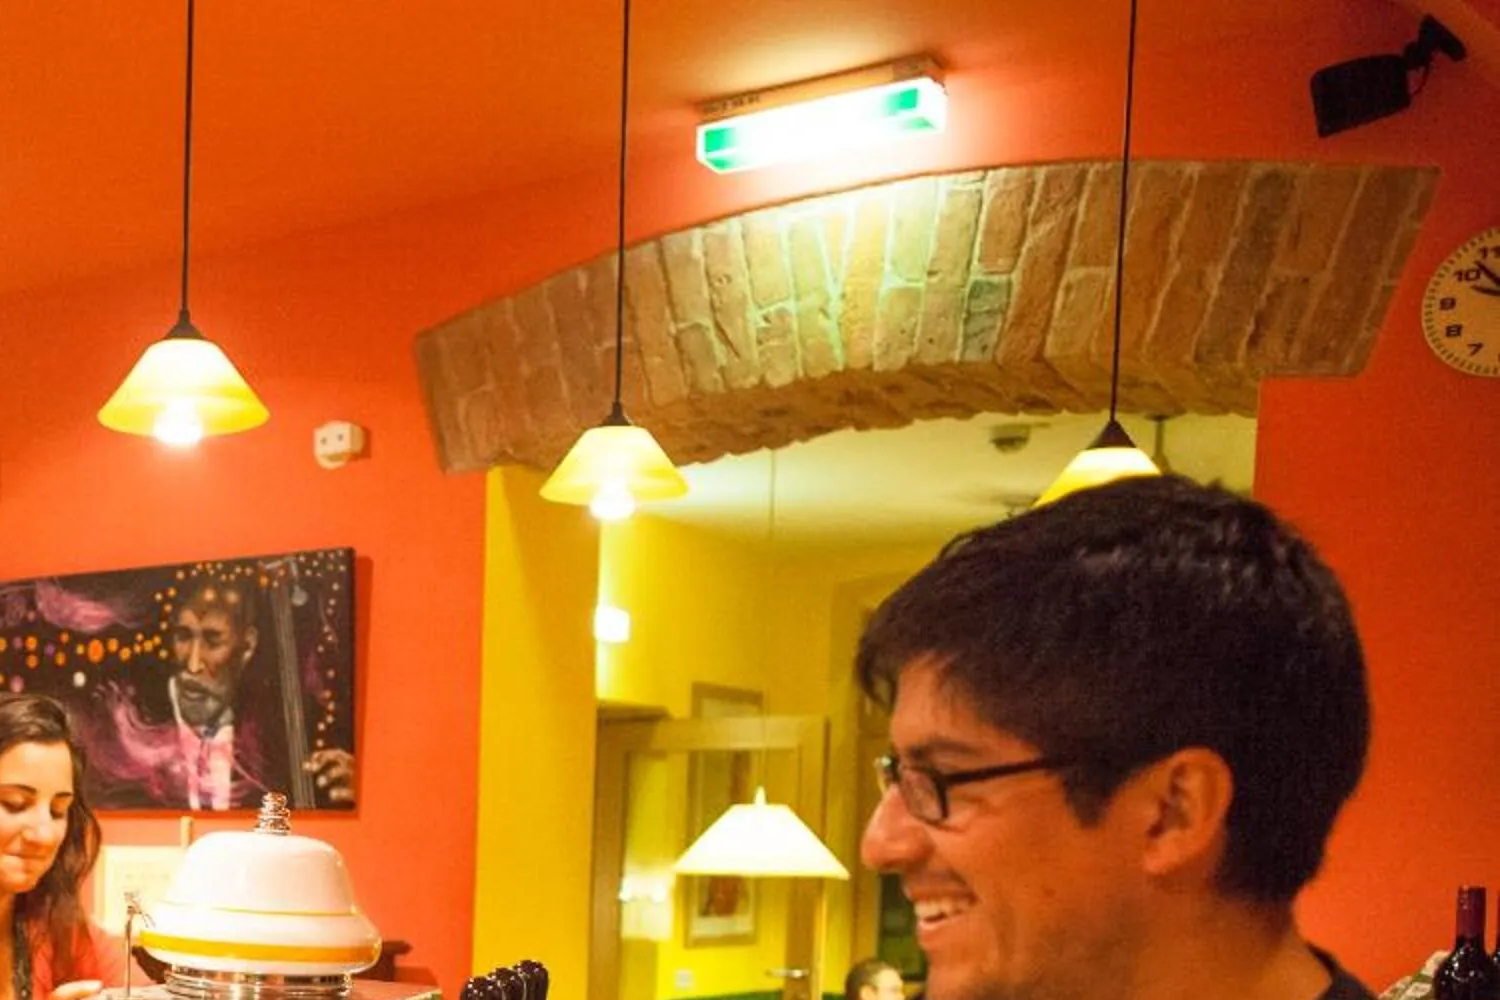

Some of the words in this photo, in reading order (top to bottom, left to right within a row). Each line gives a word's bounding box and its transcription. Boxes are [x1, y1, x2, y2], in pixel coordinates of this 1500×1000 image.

[1453, 268, 1481, 282] 10
[1445, 324, 1463, 338] 8
[1467, 342, 1484, 356] 7
